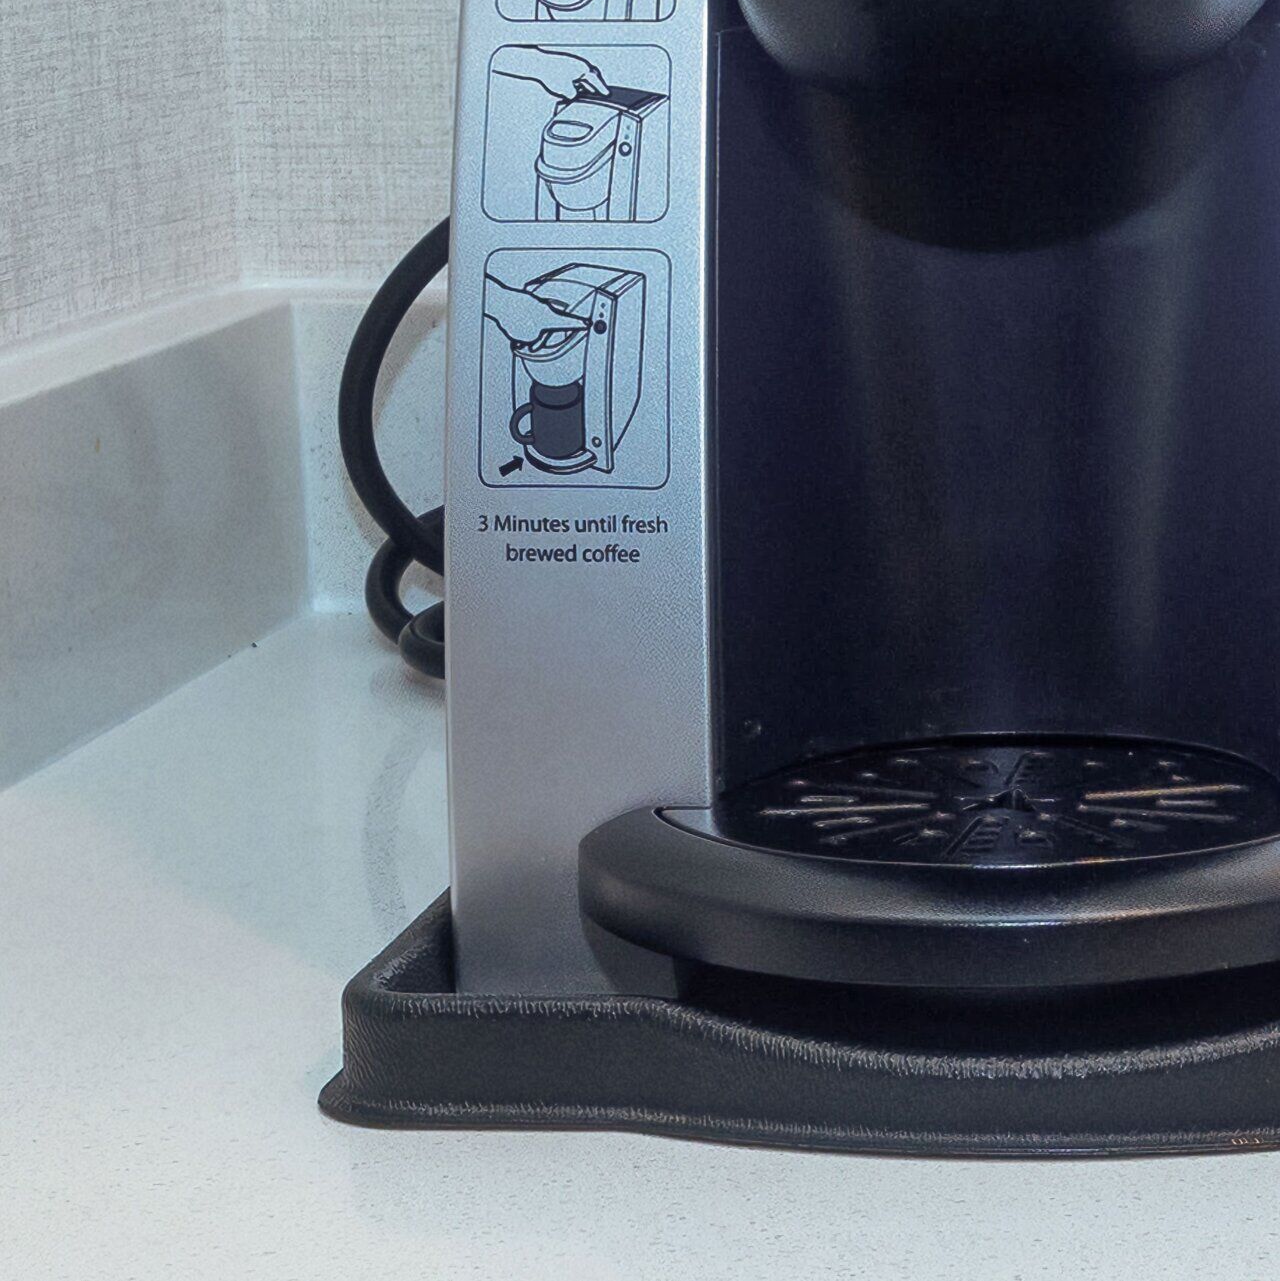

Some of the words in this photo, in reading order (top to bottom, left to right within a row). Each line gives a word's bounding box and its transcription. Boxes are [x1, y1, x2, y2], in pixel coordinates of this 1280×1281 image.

[478, 514, 489, 532] 3
[493, 514, 570, 533] Minutes
[574, 515, 617, 533] until
[621, 514, 669, 534] fresh
[506, 543, 577, 562] brewed
[582, 543, 641, 563] coffee
